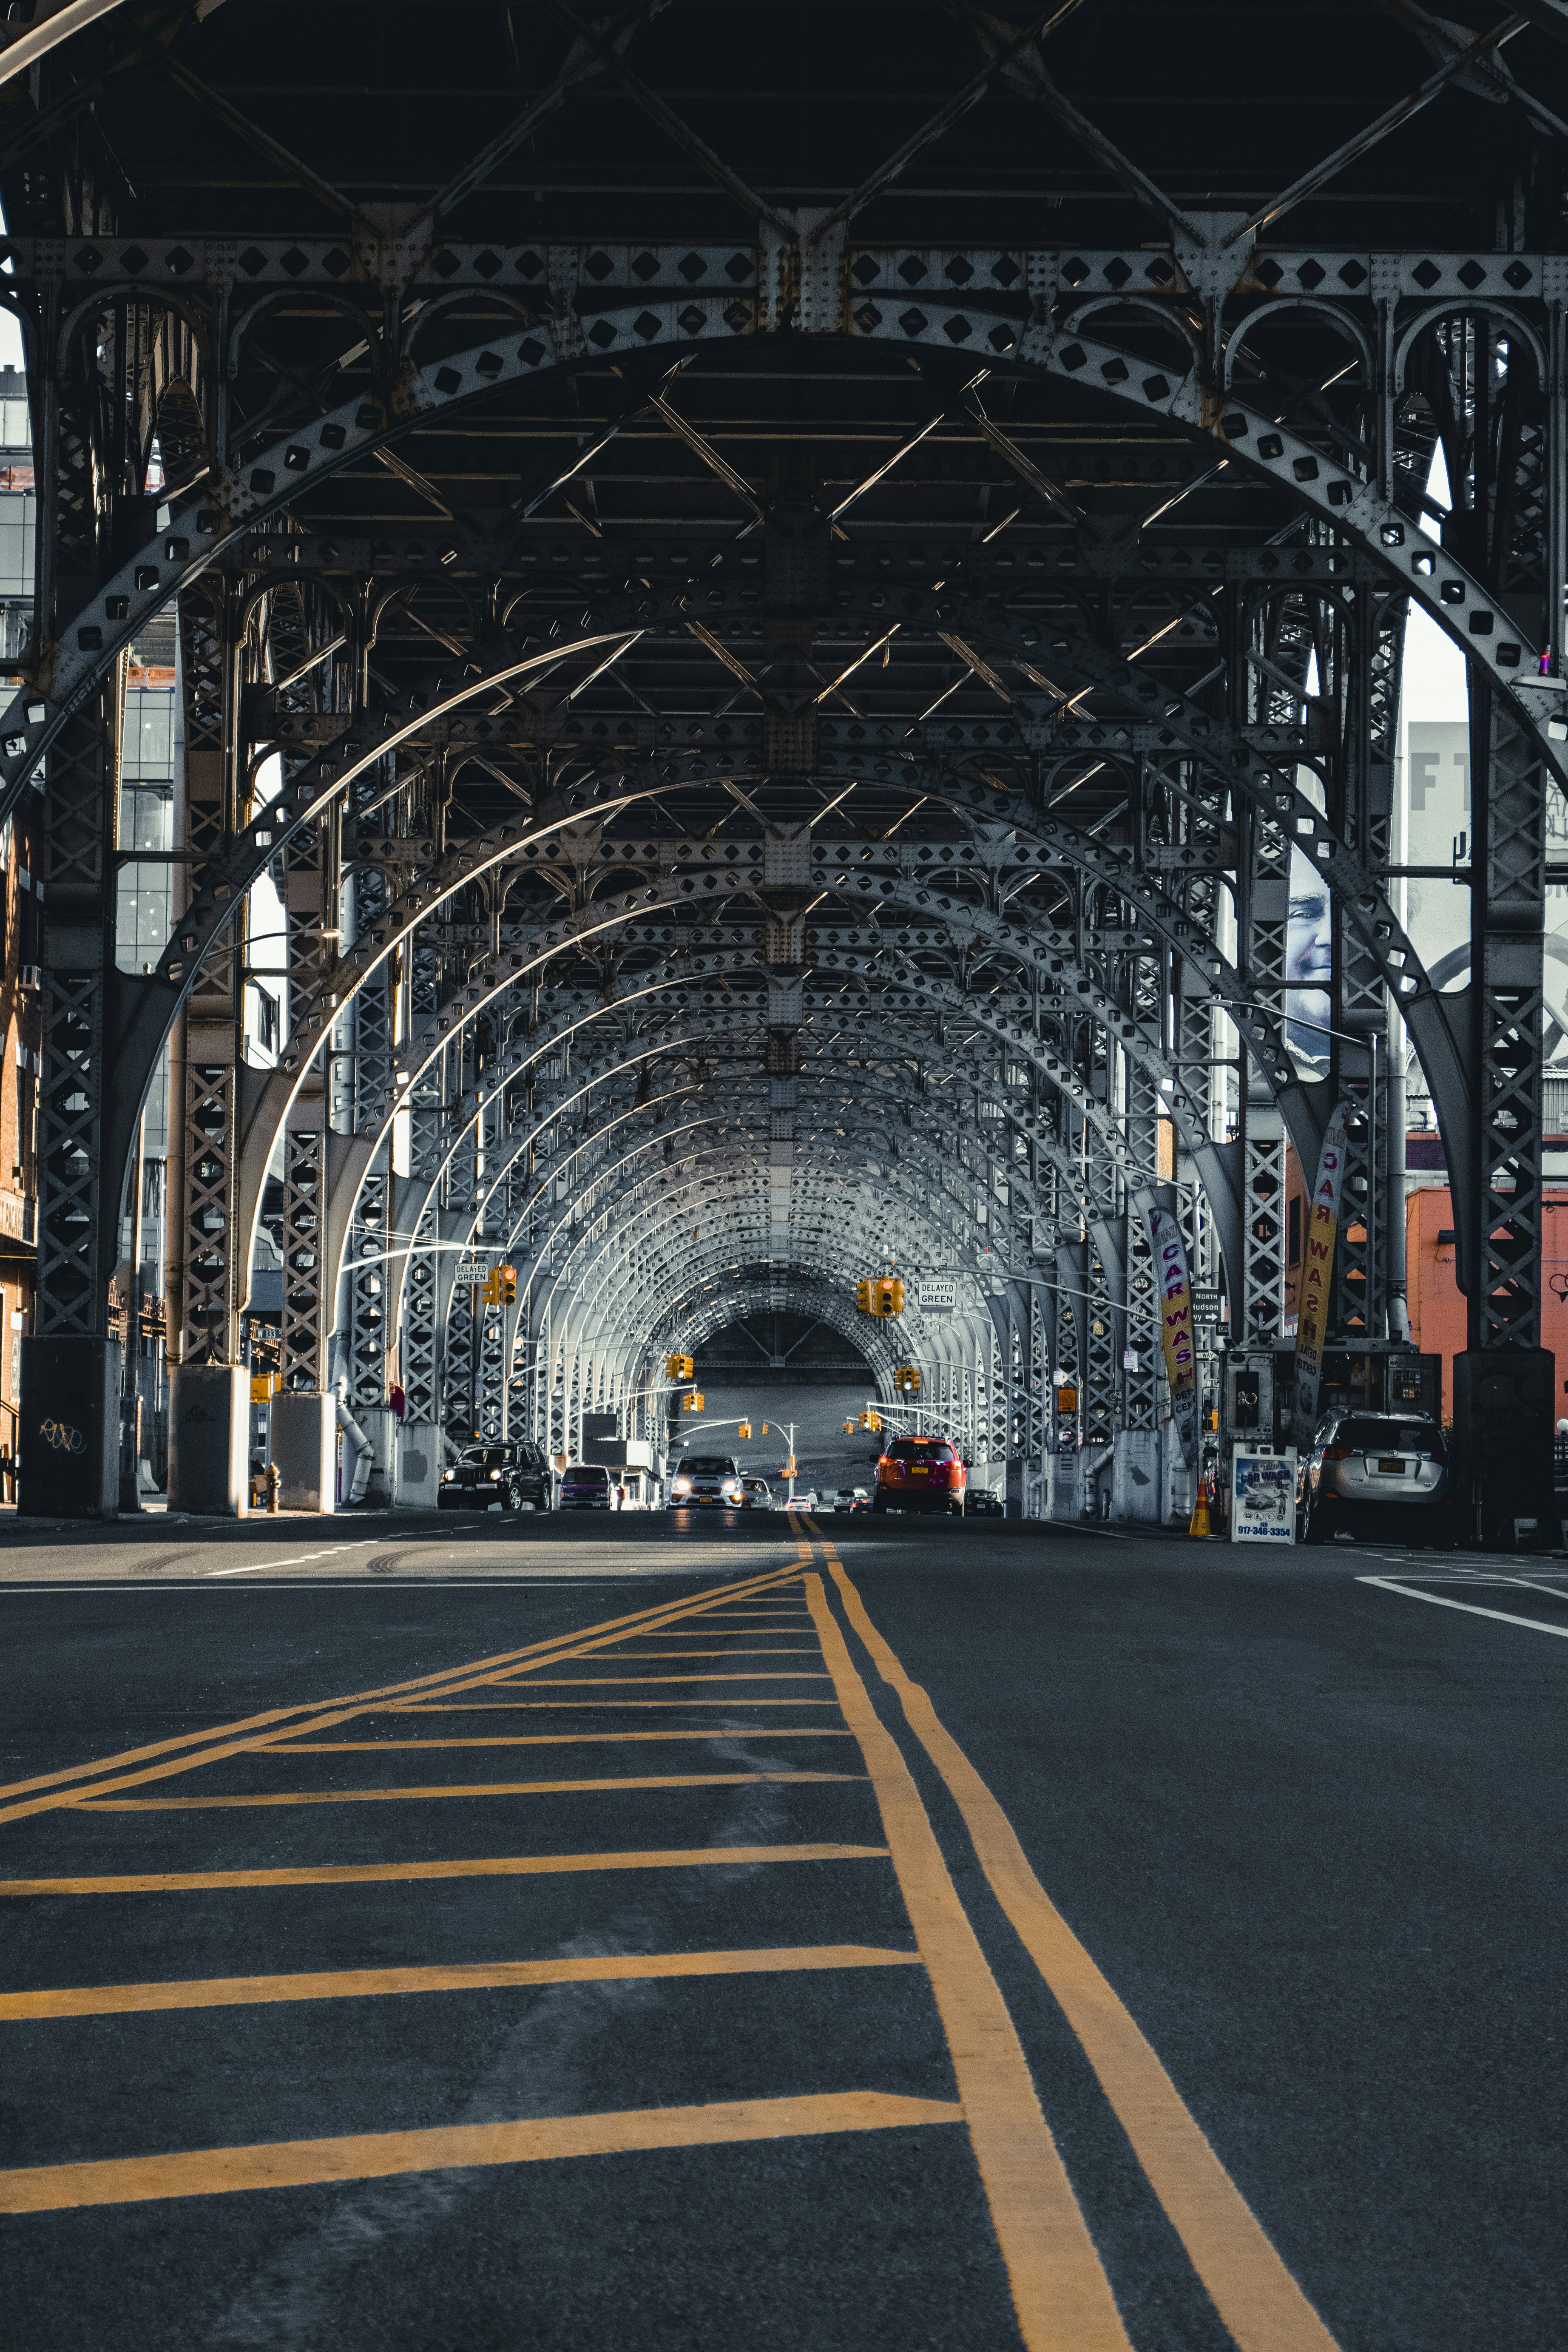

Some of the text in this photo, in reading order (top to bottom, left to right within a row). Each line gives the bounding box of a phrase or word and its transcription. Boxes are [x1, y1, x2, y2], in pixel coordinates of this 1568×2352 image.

[1162, 1243, 1193, 1387] CAR WASH
[258, 1330, 263, 1338] W
[266, 1330, 276, 1338] 133
[1241, 1470, 1290, 1483] CAR WASH
[1238, 1525, 1290, 1536] 917-346-3354
